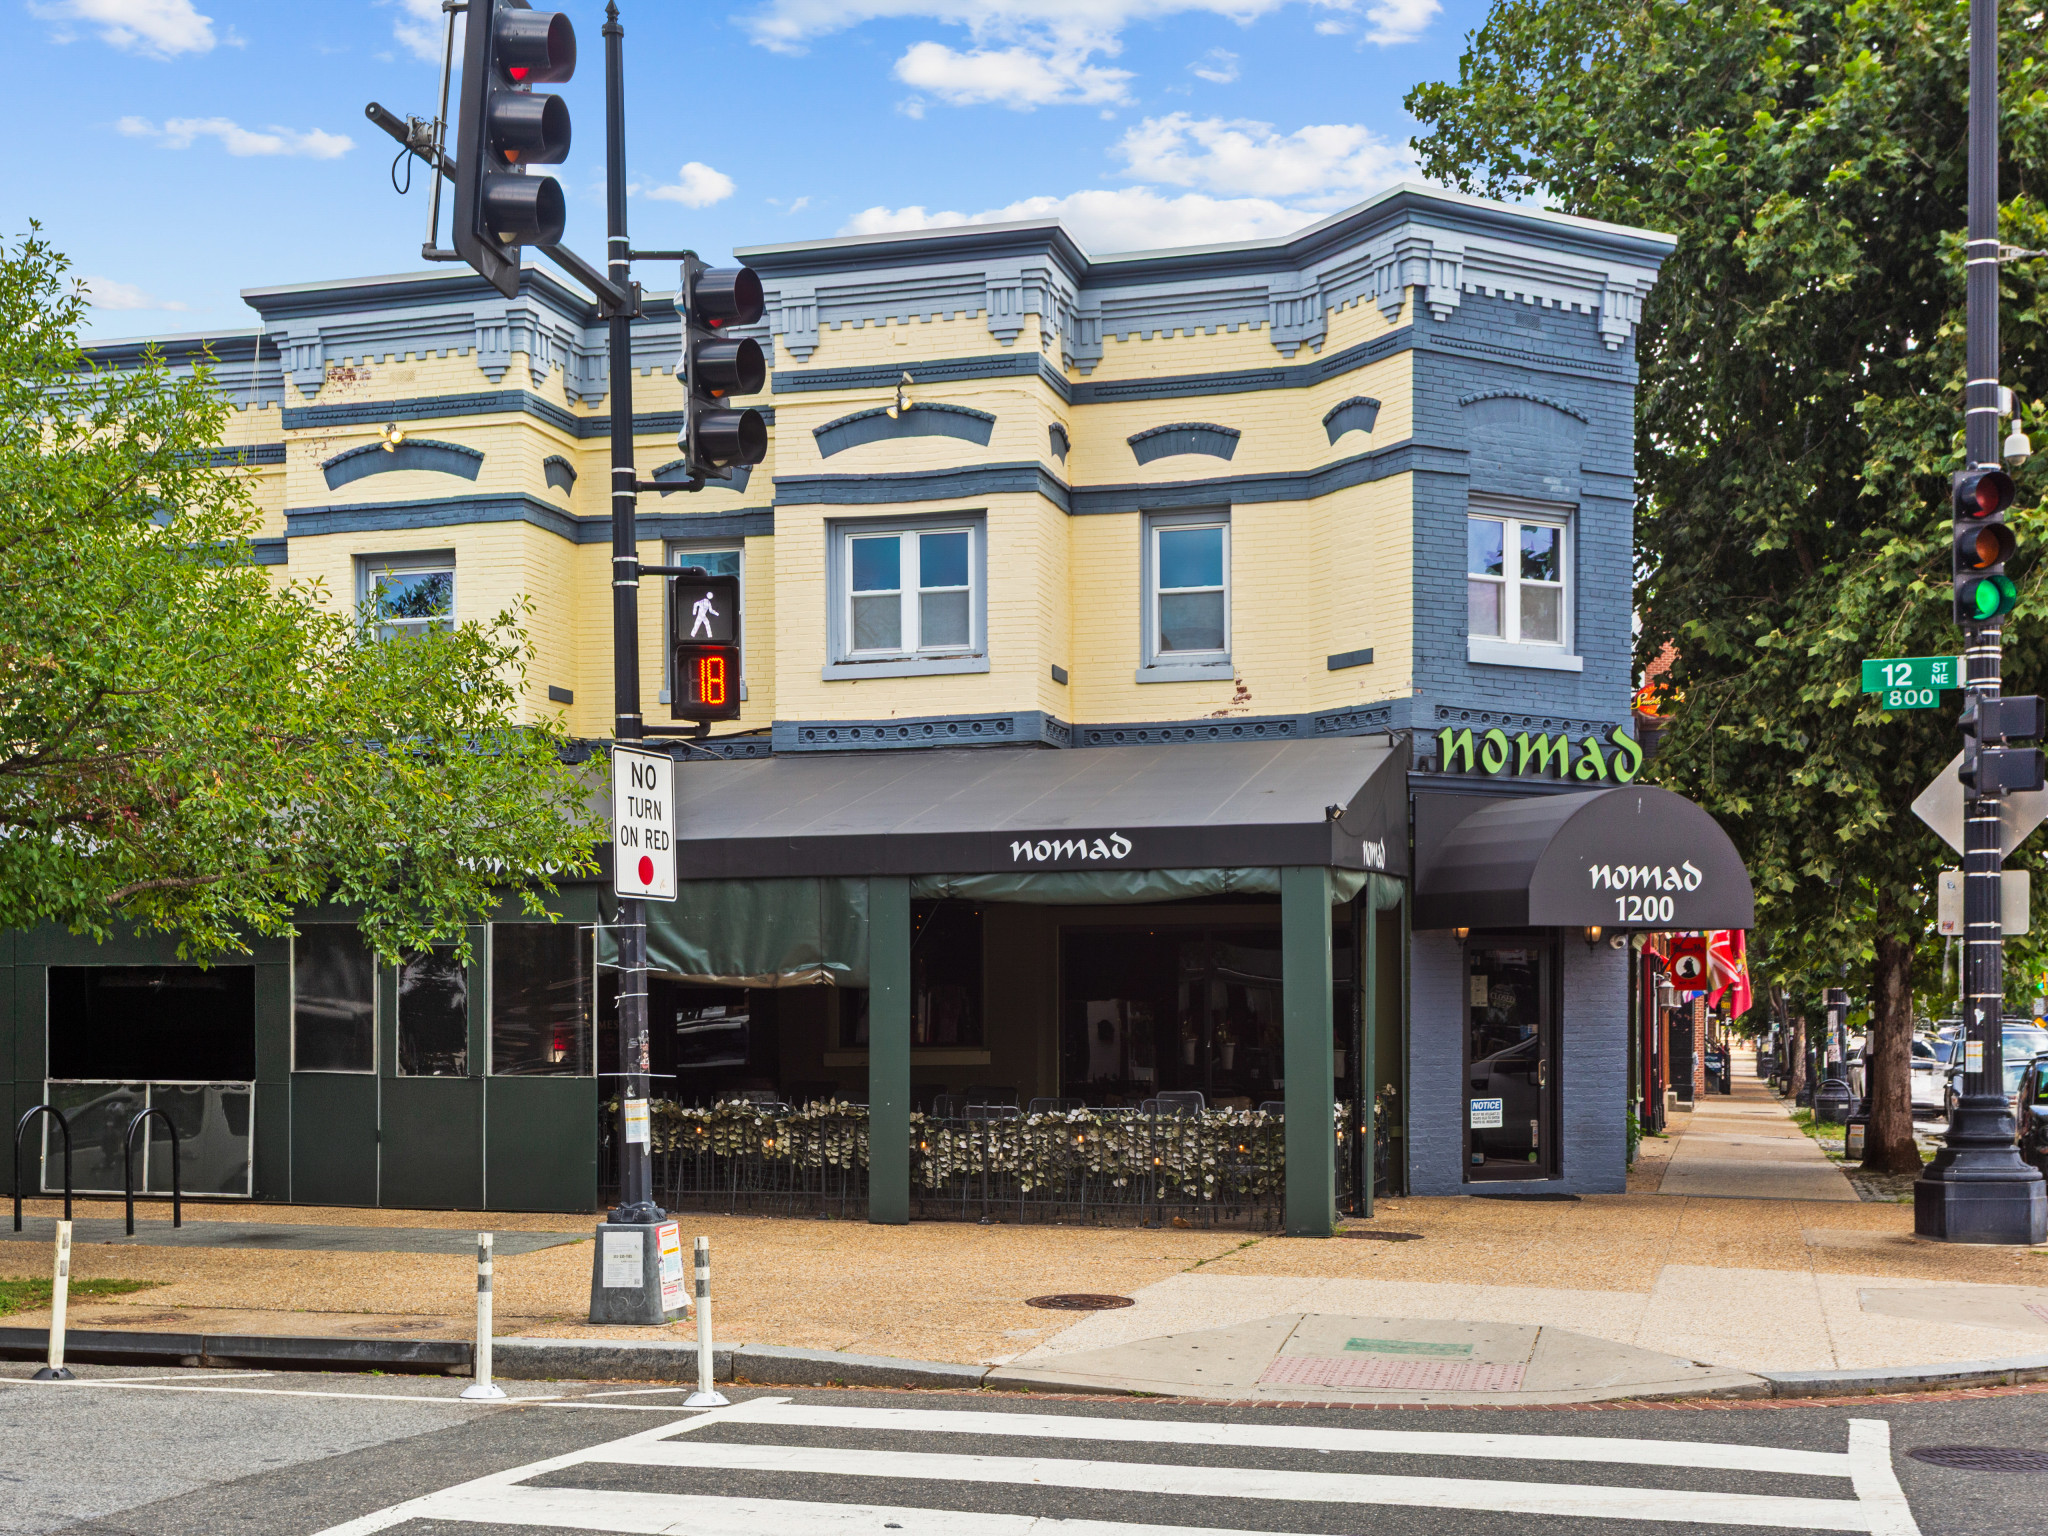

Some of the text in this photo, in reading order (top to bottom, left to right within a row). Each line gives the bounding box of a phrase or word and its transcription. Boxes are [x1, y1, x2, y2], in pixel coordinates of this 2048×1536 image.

[700, 657, 725, 704] 18
[1881, 662, 1948, 686] 12 ST
[1931, 673, 1949, 684] NE
[1889, 689, 1933, 706] 800
[1435, 725, 1643, 783] nomad
[631, 762, 657, 791] NO
[628, 795, 662, 821] TURN
[620, 825, 670, 851] ON RED
[1009, 831, 1132, 861] nomad
[1589, 860, 1702, 891] nomad
[1615, 895, 1674, 922] 1200
[1472, 1101, 1500, 1110] NOTICE
